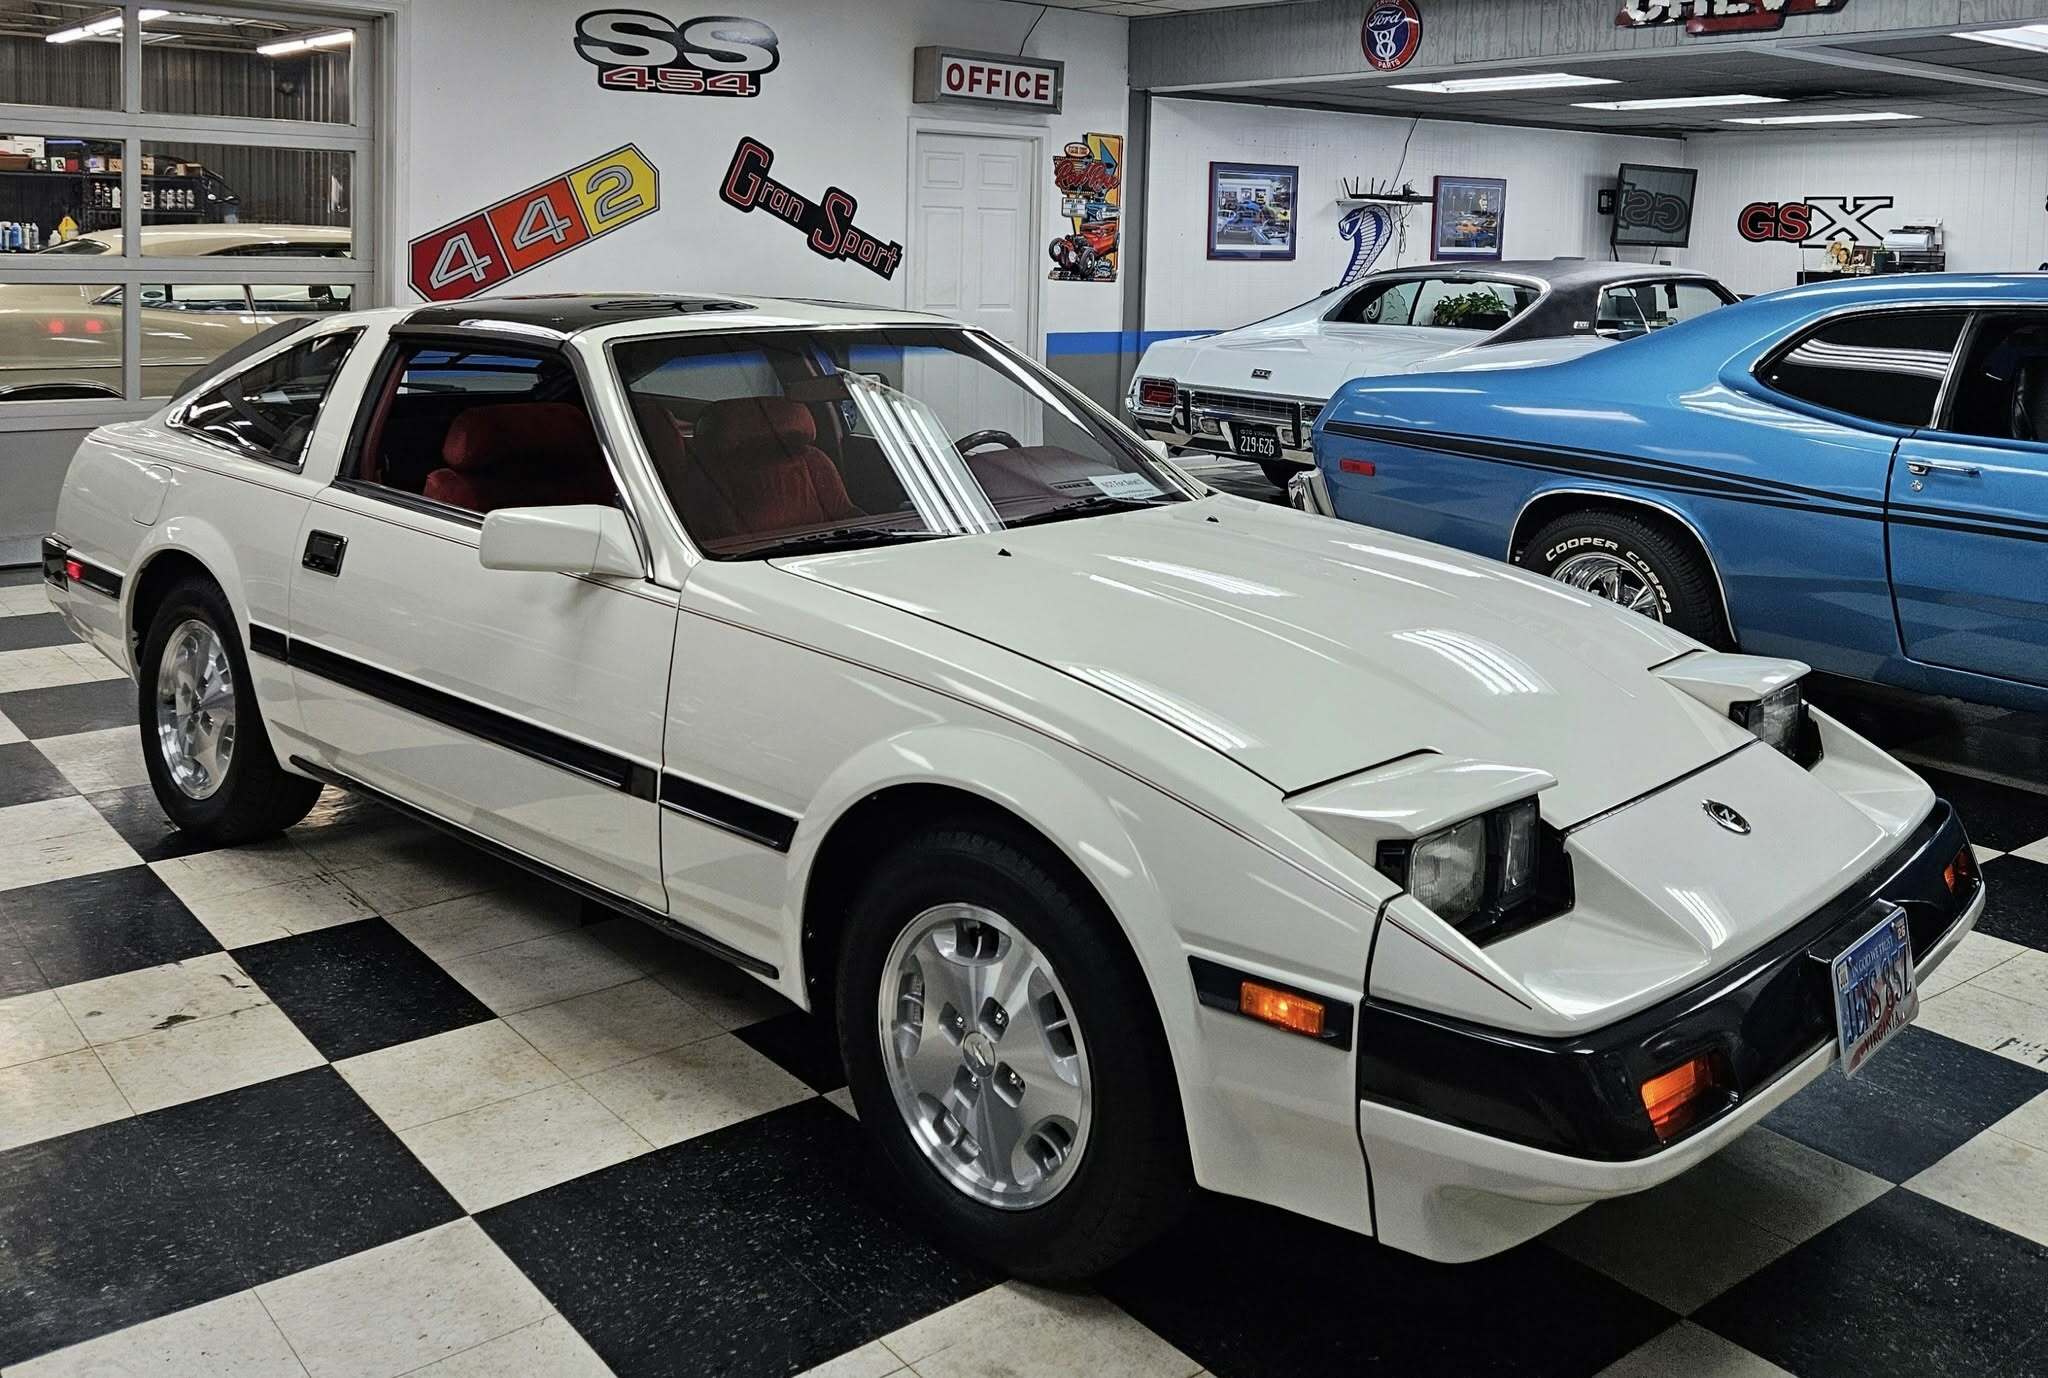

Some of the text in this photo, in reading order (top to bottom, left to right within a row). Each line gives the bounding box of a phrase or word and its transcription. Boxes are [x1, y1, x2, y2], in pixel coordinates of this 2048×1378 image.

[1369, 10, 1403, 27] Ford
[576, 10, 778, 73] SS
[602, 66, 756, 96] 454
[946, 63, 1049, 100] OFFICE
[1378, 58, 1401, 69] PARTS
[725, 142, 898, 273] Gran Sport
[1738, 196, 1893, 248] GSX
[1545, 537, 1672, 613] COOPER COBRA
[1858, 957, 1871, 974] GOD
[1864, 1011, 1901, 1052] VIRGINIA
